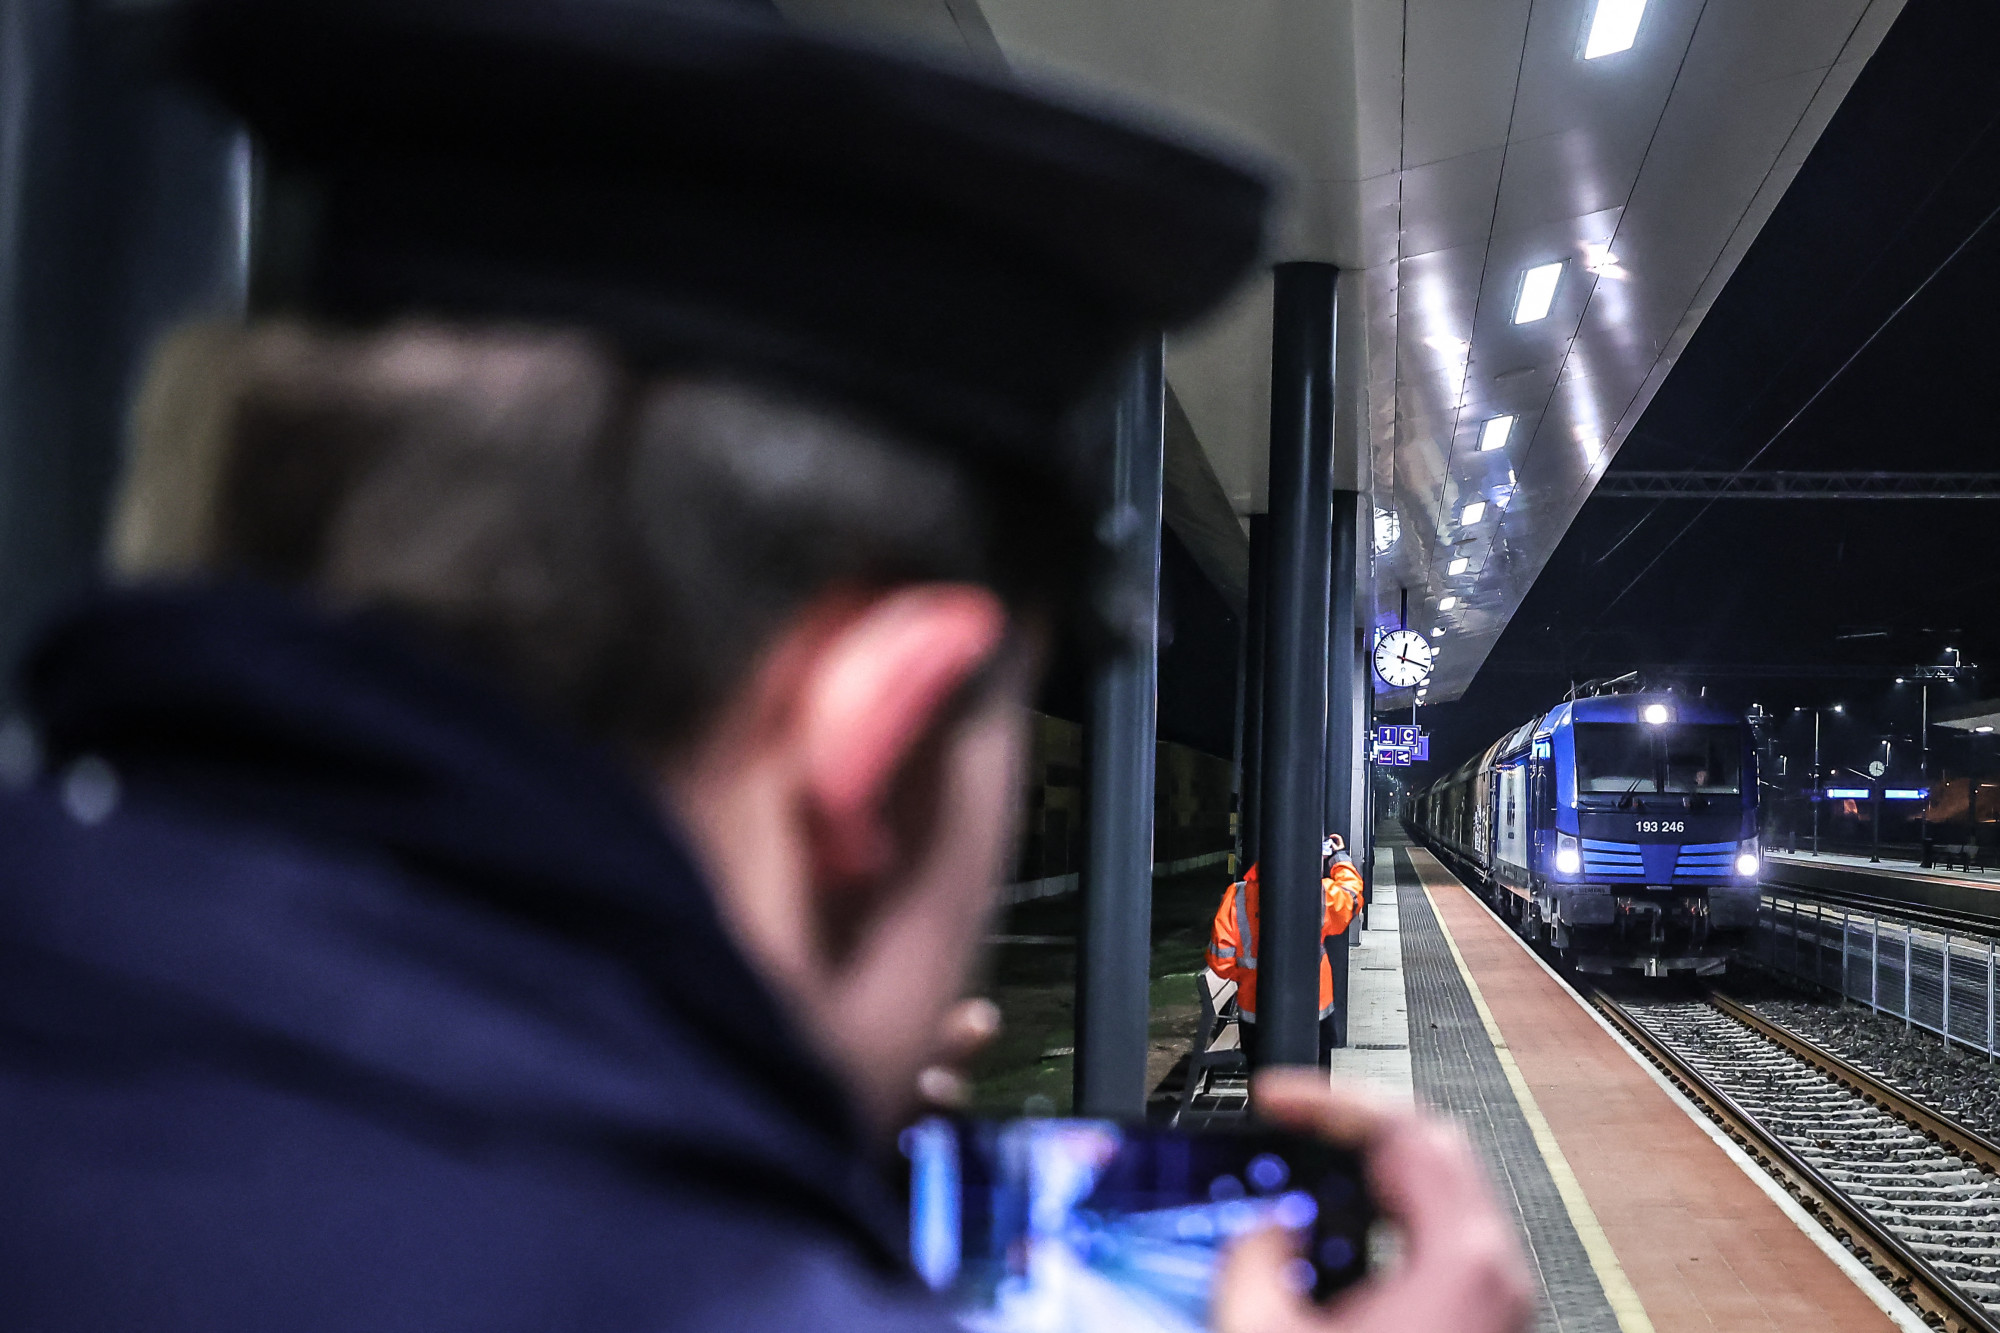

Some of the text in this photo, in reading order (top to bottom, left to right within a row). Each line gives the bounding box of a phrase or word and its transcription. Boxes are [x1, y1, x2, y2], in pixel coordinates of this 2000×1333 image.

[1384, 728, 1391, 740] 1
[1403, 729, 1414, 741] C
[1635, 820, 1684, 833] 193 246
